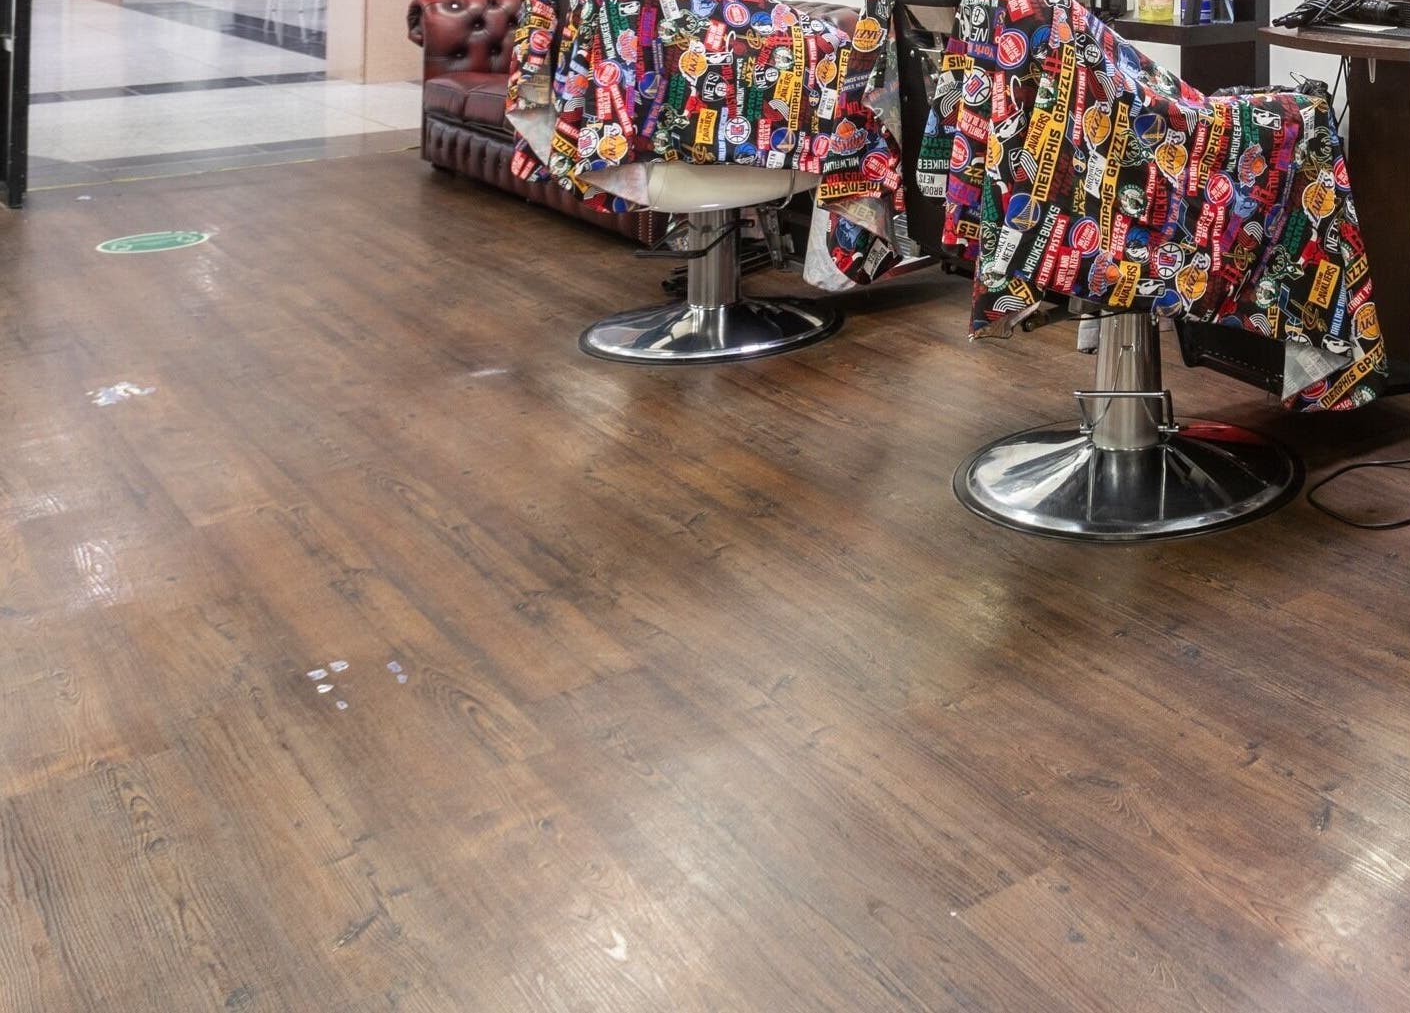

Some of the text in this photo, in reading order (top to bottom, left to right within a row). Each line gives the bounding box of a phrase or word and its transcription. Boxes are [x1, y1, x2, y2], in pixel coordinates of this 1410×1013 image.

[1075, 32, 1087, 66] NETS
[704, 73, 720, 101] NETS
[755, 63, 768, 89] NETS
[790, 27, 804, 129] MEMPHIS GRIZZLIES
[1033, 48, 1075, 200] MEMPHIS GRIZZLIES
[1072, 71, 1087, 141] DETROIT PISTONS
[1189, 127, 1206, 192] DETROIT PISTONS
[1198, 125, 1223, 189] MEMPHIS
[820, 181, 881, 197] MEMPHIS
[1040, 205, 1061, 237] BUCKS
[1051, 218, 1067, 252] PISTONS
[1101, 182, 1114, 251] MEMPHIS
[1111, 214, 1123, 256] CHICAGO
[1195, 203, 1210, 244] CHICAGO
[1002, 242, 1016, 263] NETS
[1116, 223, 1128, 254] BULLS
[1212, 206, 1225, 271] DETROIT PISTONS
[1316, 264, 1337, 305] CAVALIERS
[1330, 306, 1344, 336] DALLAS
[1320, 372, 1357, 408] MEMPHIS
